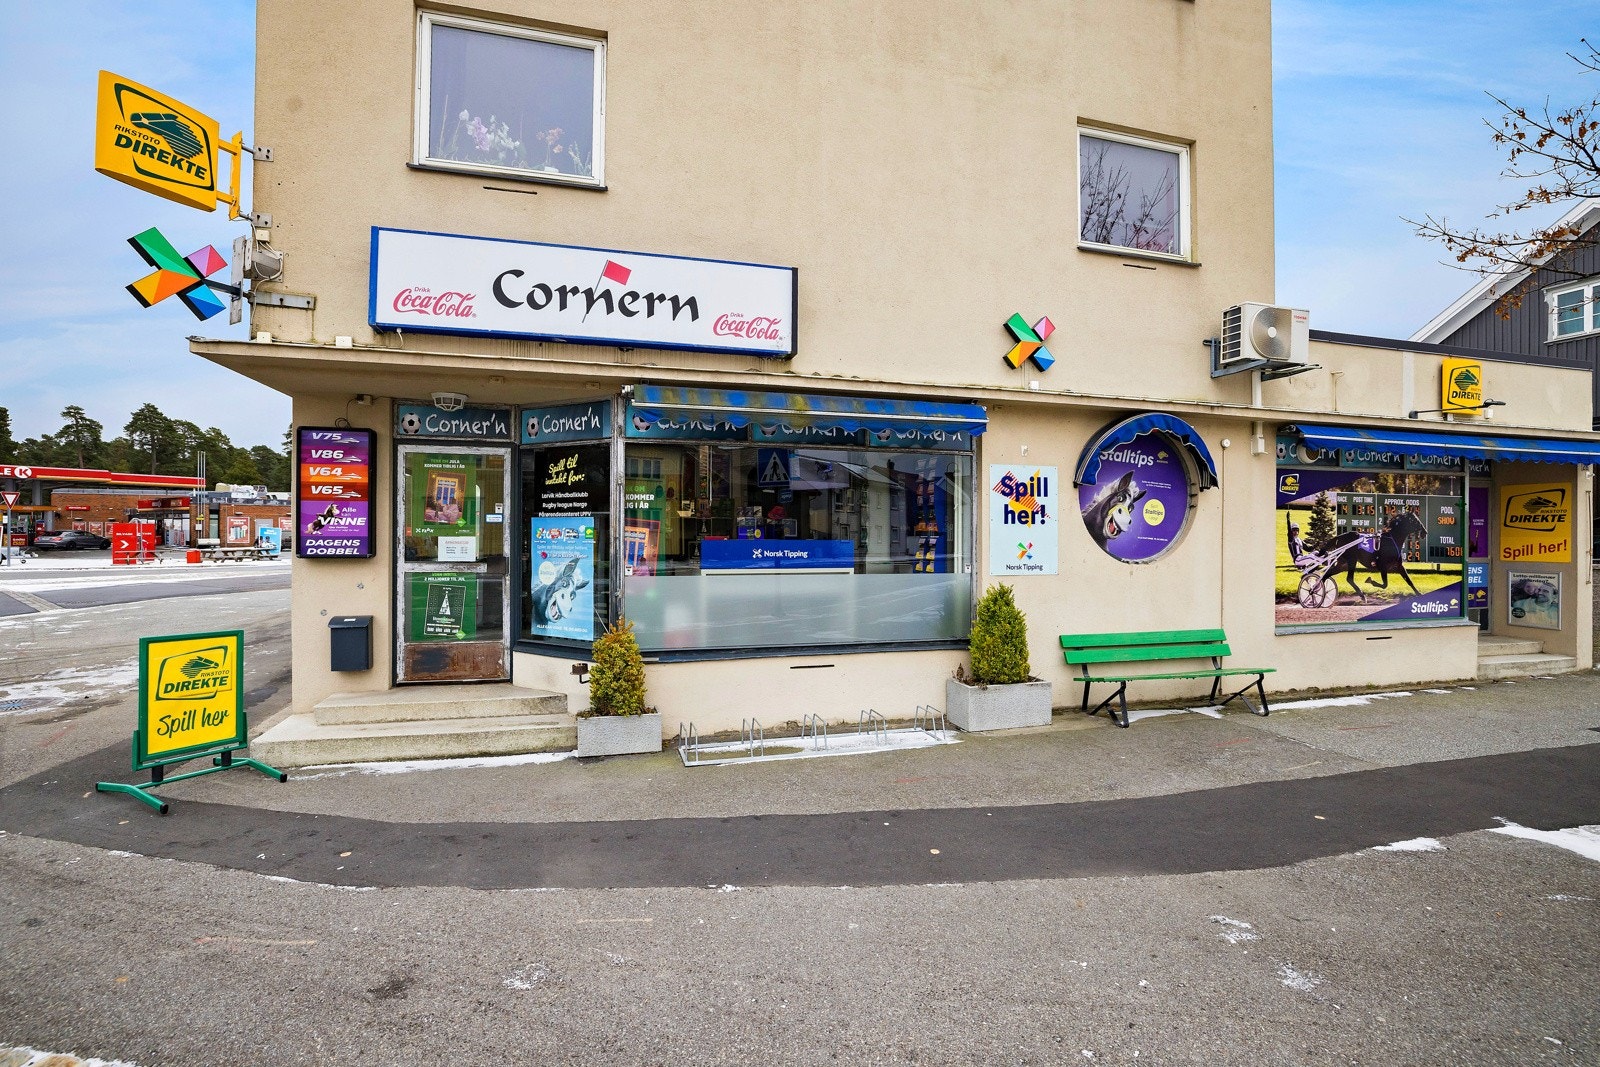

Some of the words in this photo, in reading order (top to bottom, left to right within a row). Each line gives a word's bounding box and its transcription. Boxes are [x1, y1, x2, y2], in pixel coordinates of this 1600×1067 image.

[115, 124, 161, 145] RIKSTOTO
[115, 133, 208, 180] DIREKTE
[393, 288, 476, 318] Coca-Cola
[493, 268, 699, 322] Cornern
[713, 313, 782, 340] Coca-Cola
[1452, 390, 1481, 400] DIREKTE
[425, 413, 508, 436] Corner'n
[542, 407, 600, 434] Corner'n
[310, 450, 344, 458] V86
[1100, 450, 1154, 468] Stalltips
[309, 467, 342, 476] V64
[568, 470, 585, 486] for:
[310, 486, 343, 494] V65
[1000, 475, 1048, 502] Spill
[320, 518, 366, 526] VINNE
[1004, 504, 1046, 525] her!
[1509, 514, 1566, 522] DIREKTE
[784, 550, 808, 558] Tipping
[1503, 544, 1533, 560] Spill
[1539, 539, 1567, 554] her!
[1411, 601, 1448, 614] Stalltips
[200, 670, 230, 678] RIKSTOTO
[164, 676, 229, 694] DIREKTE
[157, 710, 197, 738] Spill
[201, 708, 229, 728] her
